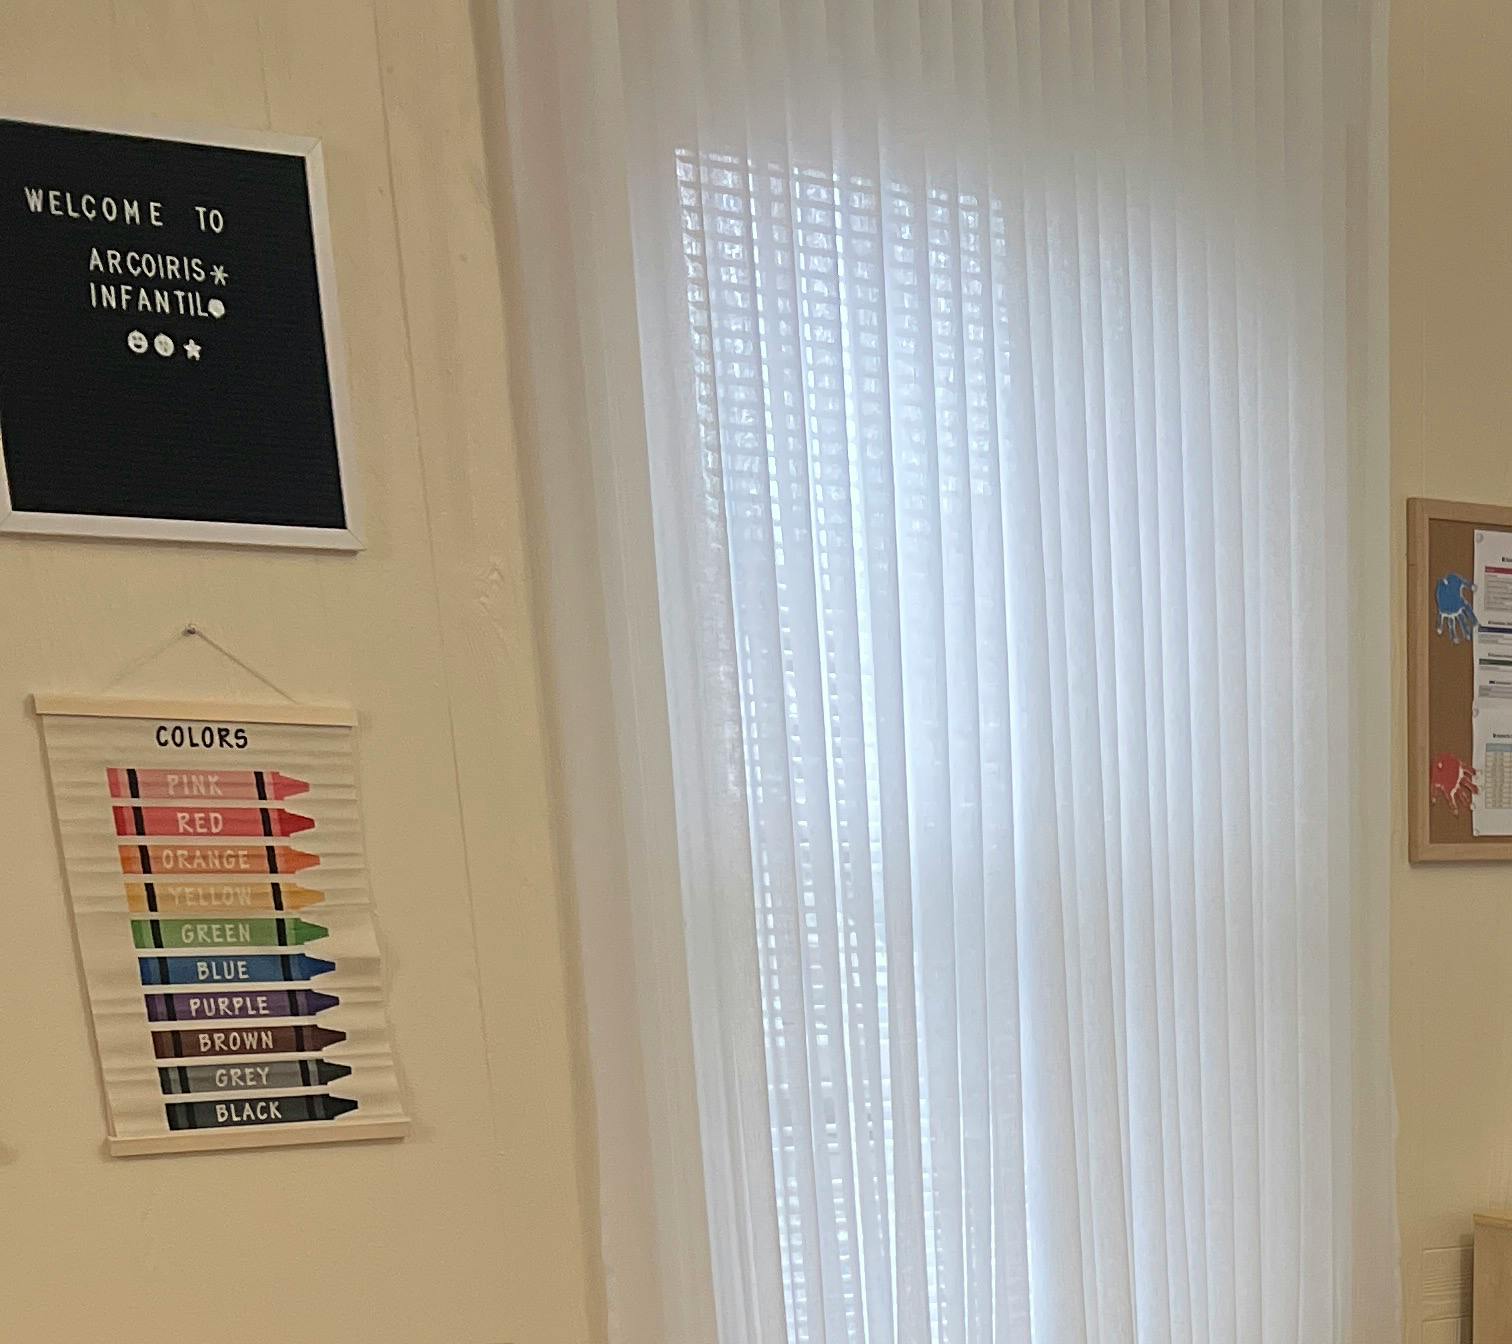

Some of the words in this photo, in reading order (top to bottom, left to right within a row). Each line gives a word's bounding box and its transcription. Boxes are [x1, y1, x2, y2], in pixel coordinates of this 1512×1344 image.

[24, 186, 164, 228] WELCOME
[195, 205, 225, 234] TO
[90, 282, 209, 318] INFANTIL
[155, 725, 249, 750] COLORS
[167, 773, 224, 797] PINK
[176, 811, 224, 835] RED
[161, 848, 251, 871] ORANGE
[168, 886, 253, 907] YELLOW
[180, 923, 252, 945] GREEN
[196, 960, 250, 981] BLUE
[189, 995, 271, 1017] PURPLE
[198, 1029, 274, 1053] BROWN
[214, 1067, 271, 1088] GREY
[215, 1101, 283, 1123] BLACK
